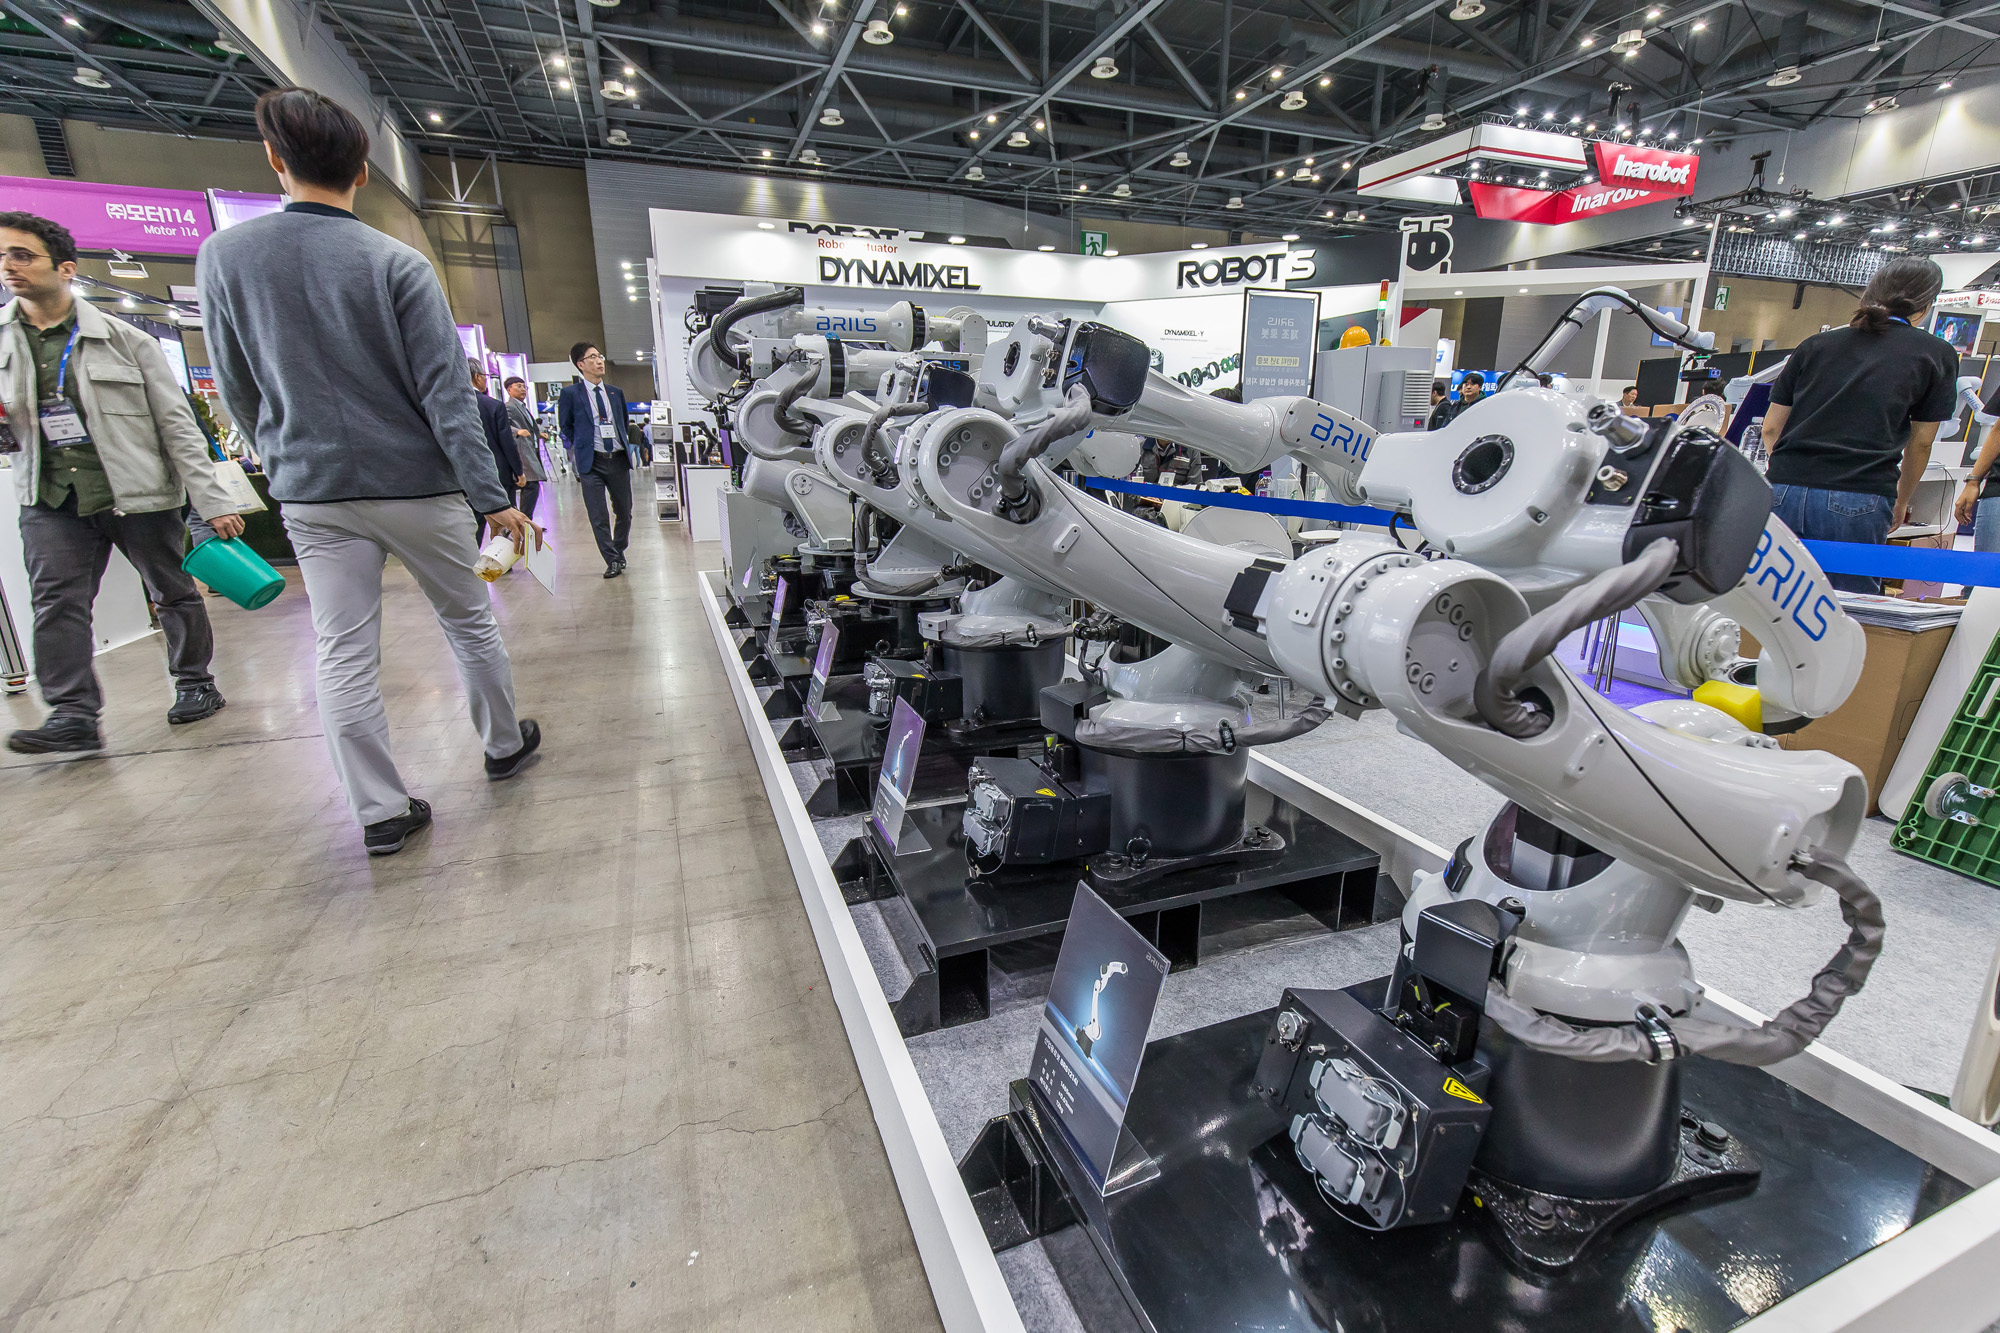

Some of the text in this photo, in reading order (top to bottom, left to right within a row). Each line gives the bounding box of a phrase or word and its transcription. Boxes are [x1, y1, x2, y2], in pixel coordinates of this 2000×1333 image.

[1613, 154, 1690, 185] Inarobot
[1571, 188, 1651, 213] Inarob
[144, 224, 200, 238] Motor 114
[818, 238, 898, 254] Robo tuator
[819, 256, 981, 290] DYNAMIXEL
[816, 316, 877, 333] BRILS
[1310, 413, 1371, 462] BRIL
